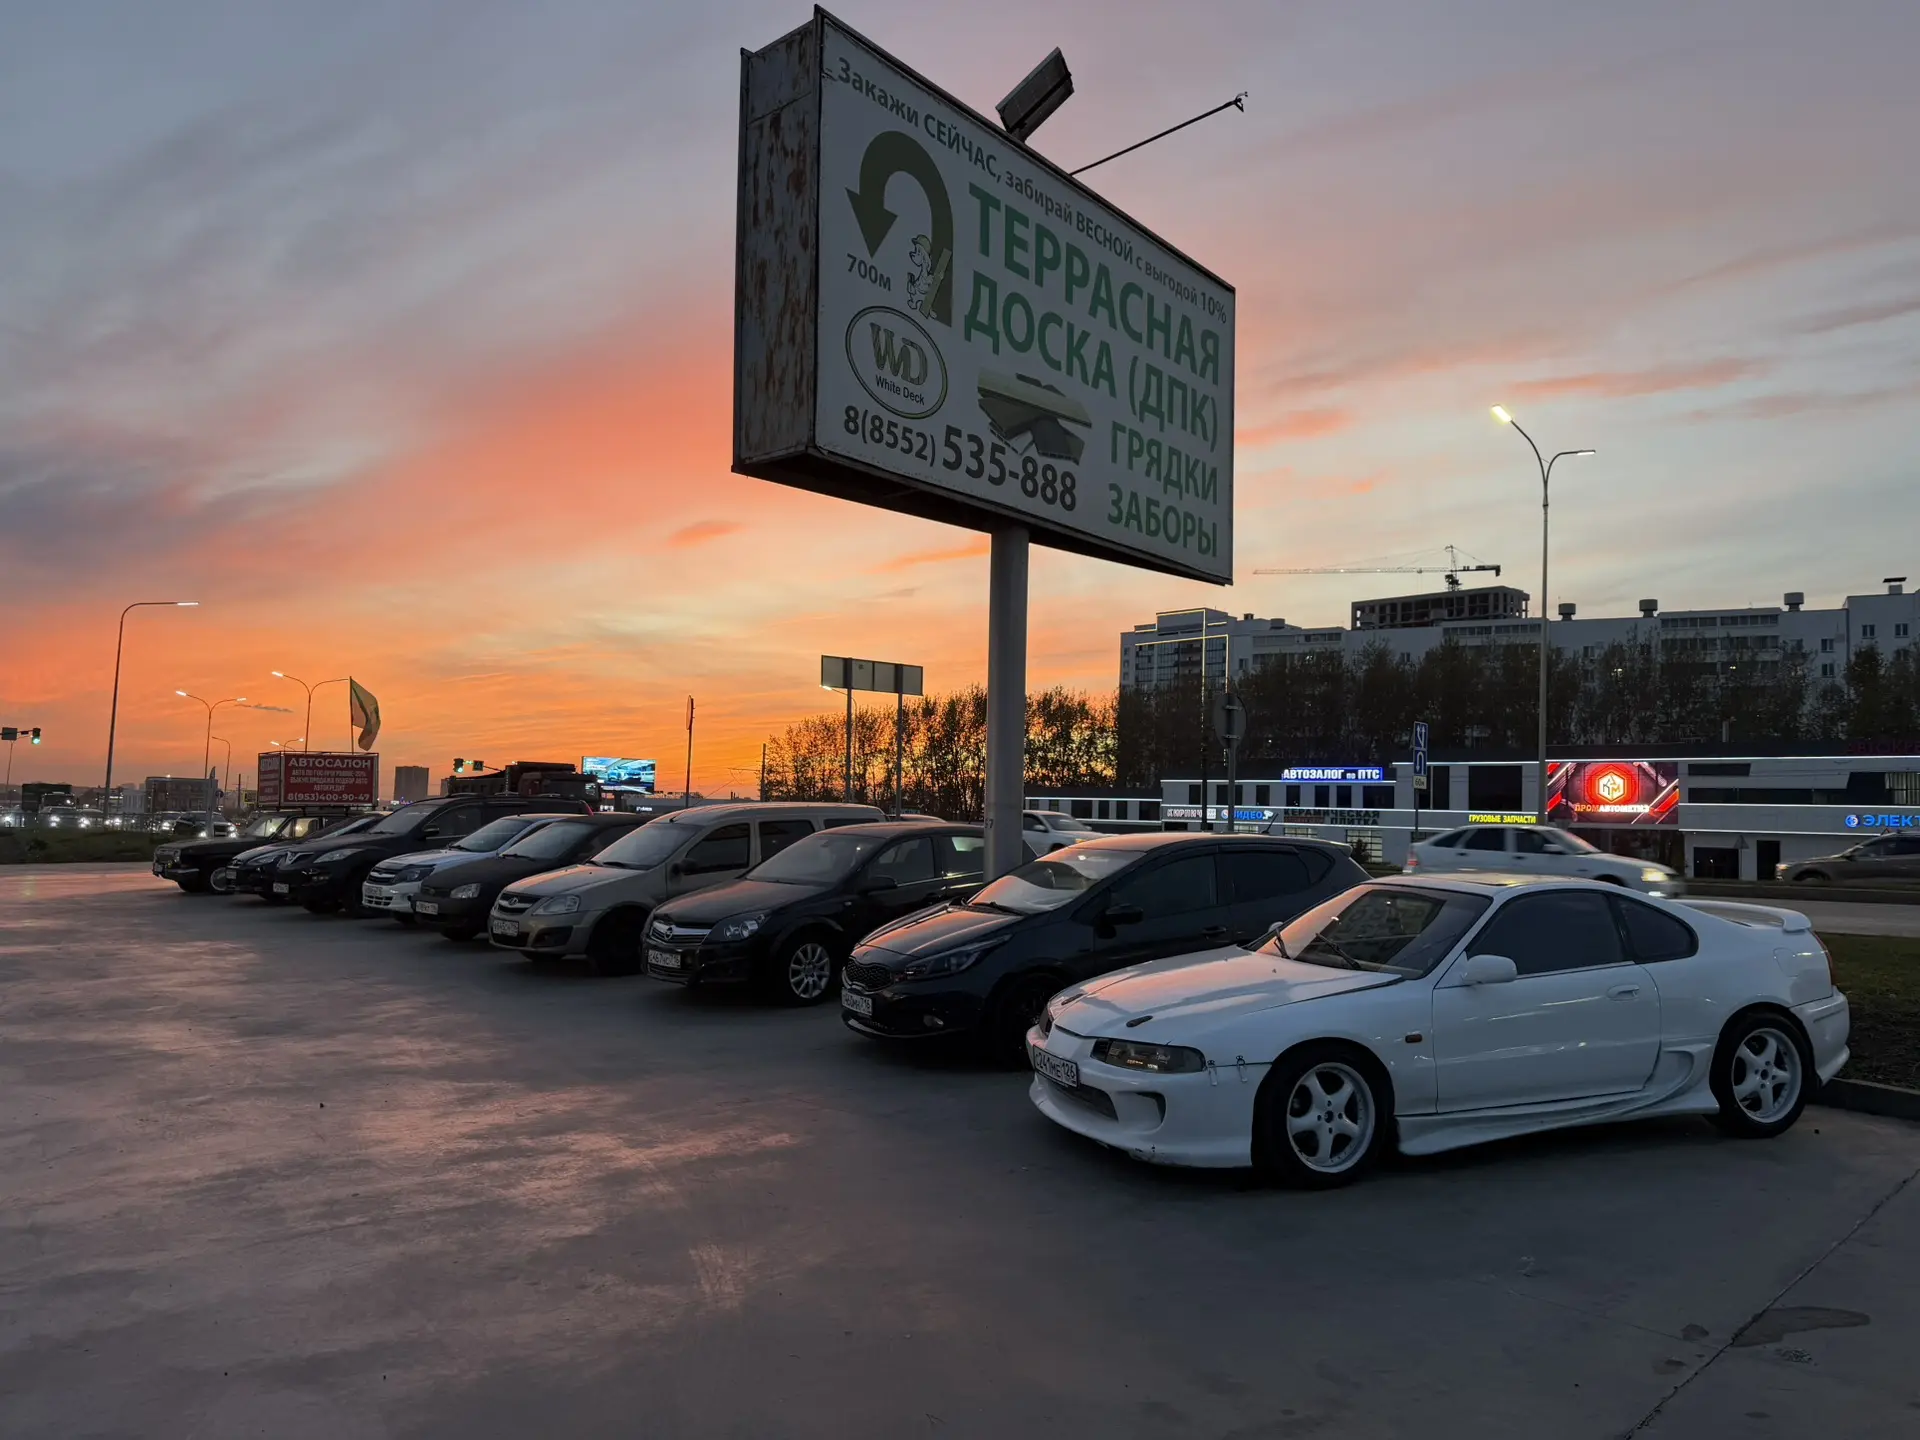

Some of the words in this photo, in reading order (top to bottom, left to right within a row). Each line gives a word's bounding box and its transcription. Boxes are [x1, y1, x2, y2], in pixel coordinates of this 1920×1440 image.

[837, 57, 919, 128] Закажи
[923, 113, 1001, 183] СЕЙЧАС,
[1005, 170, 1073, 226] забирай
[1076, 210, 1134, 266] ВЕСНОЙ
[1135, 256, 1144, 271] с
[1145, 260, 1198, 306] выгодой
[1200, 291, 1227, 324] 10%
[846, 253, 892, 292] 700м
[968, 182, 1220, 387] ТЕРРАСНАЯ
[964, 269, 1117, 399] ДОСКА
[1128, 355, 1219, 453] (ДПК)
[875, 374, 901, 396] White
[902, 386, 925, 406] Deck
[843, 405, 936, 467] 8(8552)
[942, 424, 1077, 512] 535-888
[1110, 420, 1218, 505] ГРЯДКИ
[1107, 482, 1218, 558] ЗАБОРЫ
[288, 757, 371, 769] АВТОСАЛОН
[1283, 768, 1345, 780] АВТОЗАЛОГ
[1346, 772, 1357, 780] по
[1357, 769, 1380, 780] ПТС
[287, 792, 370, 802] 8(953)400-90-47
[1167, 808, 1202, 818] КИРПИЧ
[1234, 810, 1263, 820] ИДЕО
[1284, 808, 1380, 819] КЕРАМИЧЕСКАЯ
[1330, 817, 1379, 826] ПЛИТКА
[1468, 814, 1501, 823] ГРУЗОВЫЕ
[1503, 815, 1536, 824] ЗАПЧАСТИ
